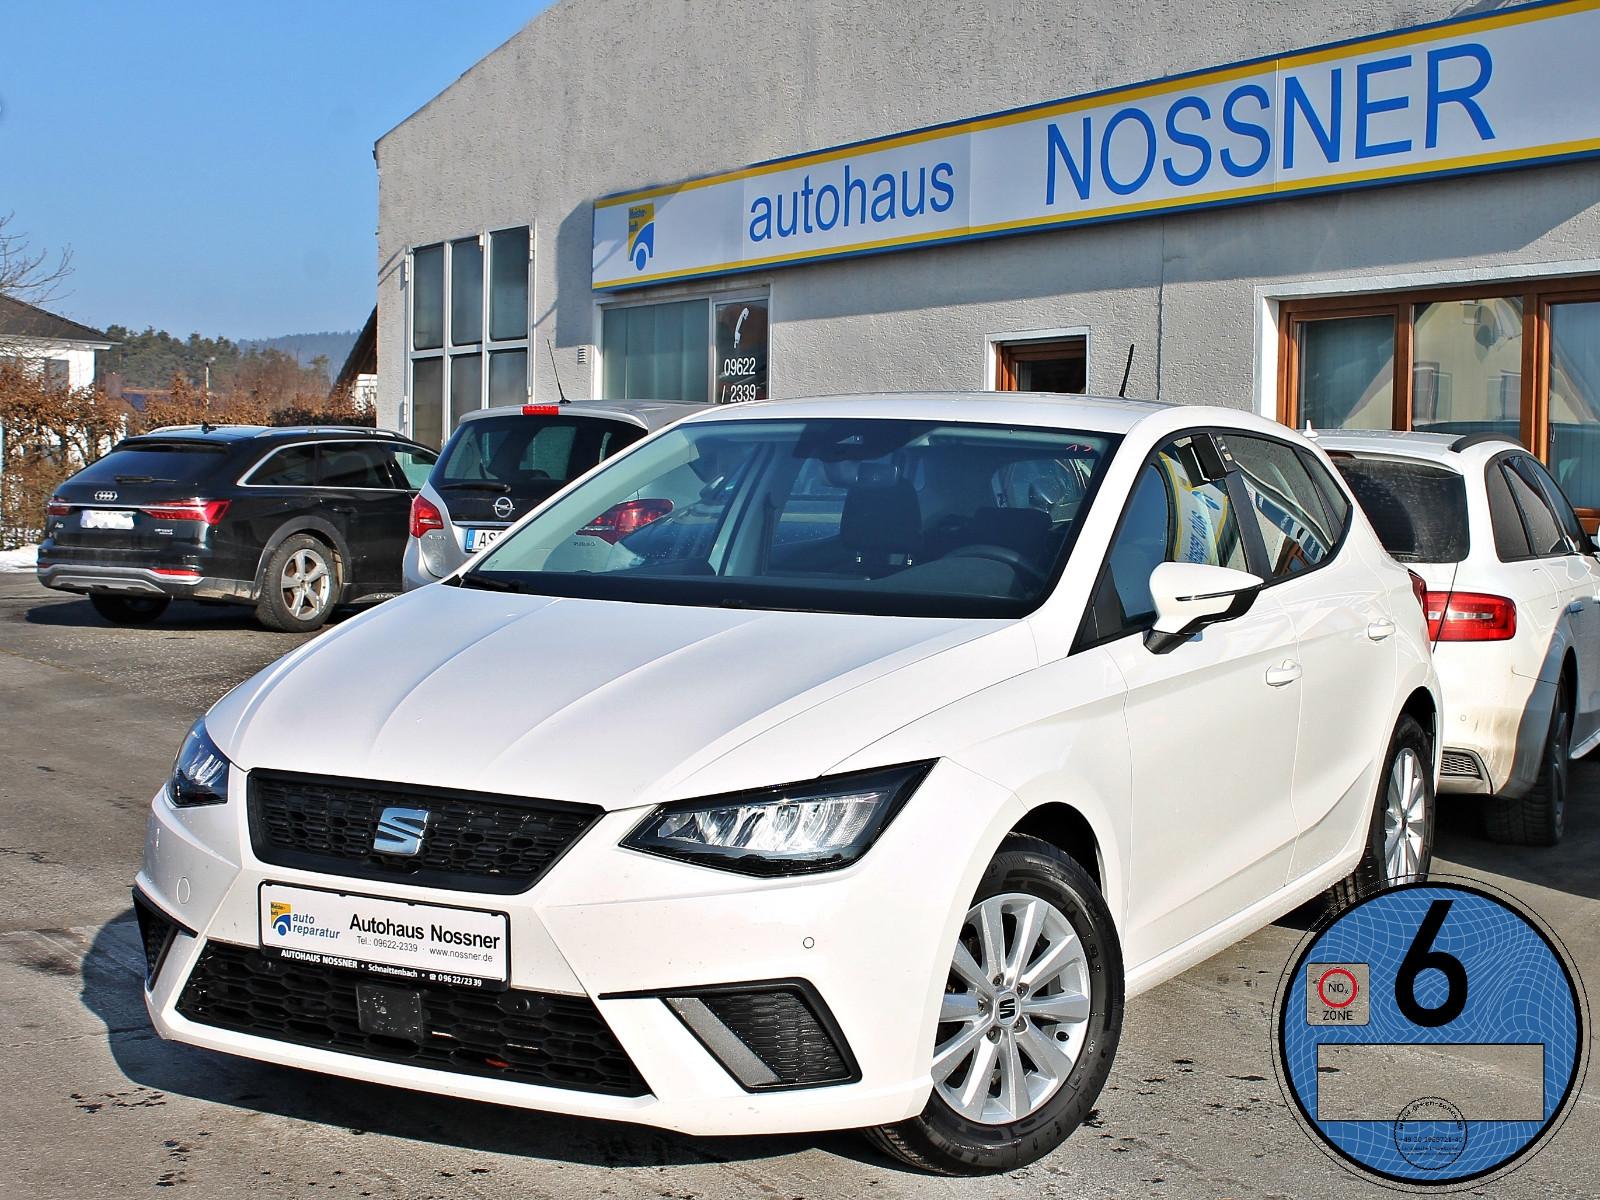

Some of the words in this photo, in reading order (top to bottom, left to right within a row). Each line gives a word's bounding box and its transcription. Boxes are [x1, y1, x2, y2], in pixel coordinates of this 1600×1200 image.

[749, 162, 954, 242] autohaus
[1045, 43, 1496, 205] NOSSNER
[724, 357, 756, 376] 09622
[730, 384, 756, 402] 2339
[292, 913, 315, 924] auto
[293, 924, 341, 939] reparatur
[349, 913, 425, 940] Autohaus
[431, 924, 500, 949] Nossner
[373, 938, 418, 952] 09622-2339
[429, 948, 493, 962] www.nossner.de
[281, 949, 321, 963] AUTOHAUS
[322, 955, 358, 969] NOSSNER
[368, 963, 418, 978] Schnaittenbach
